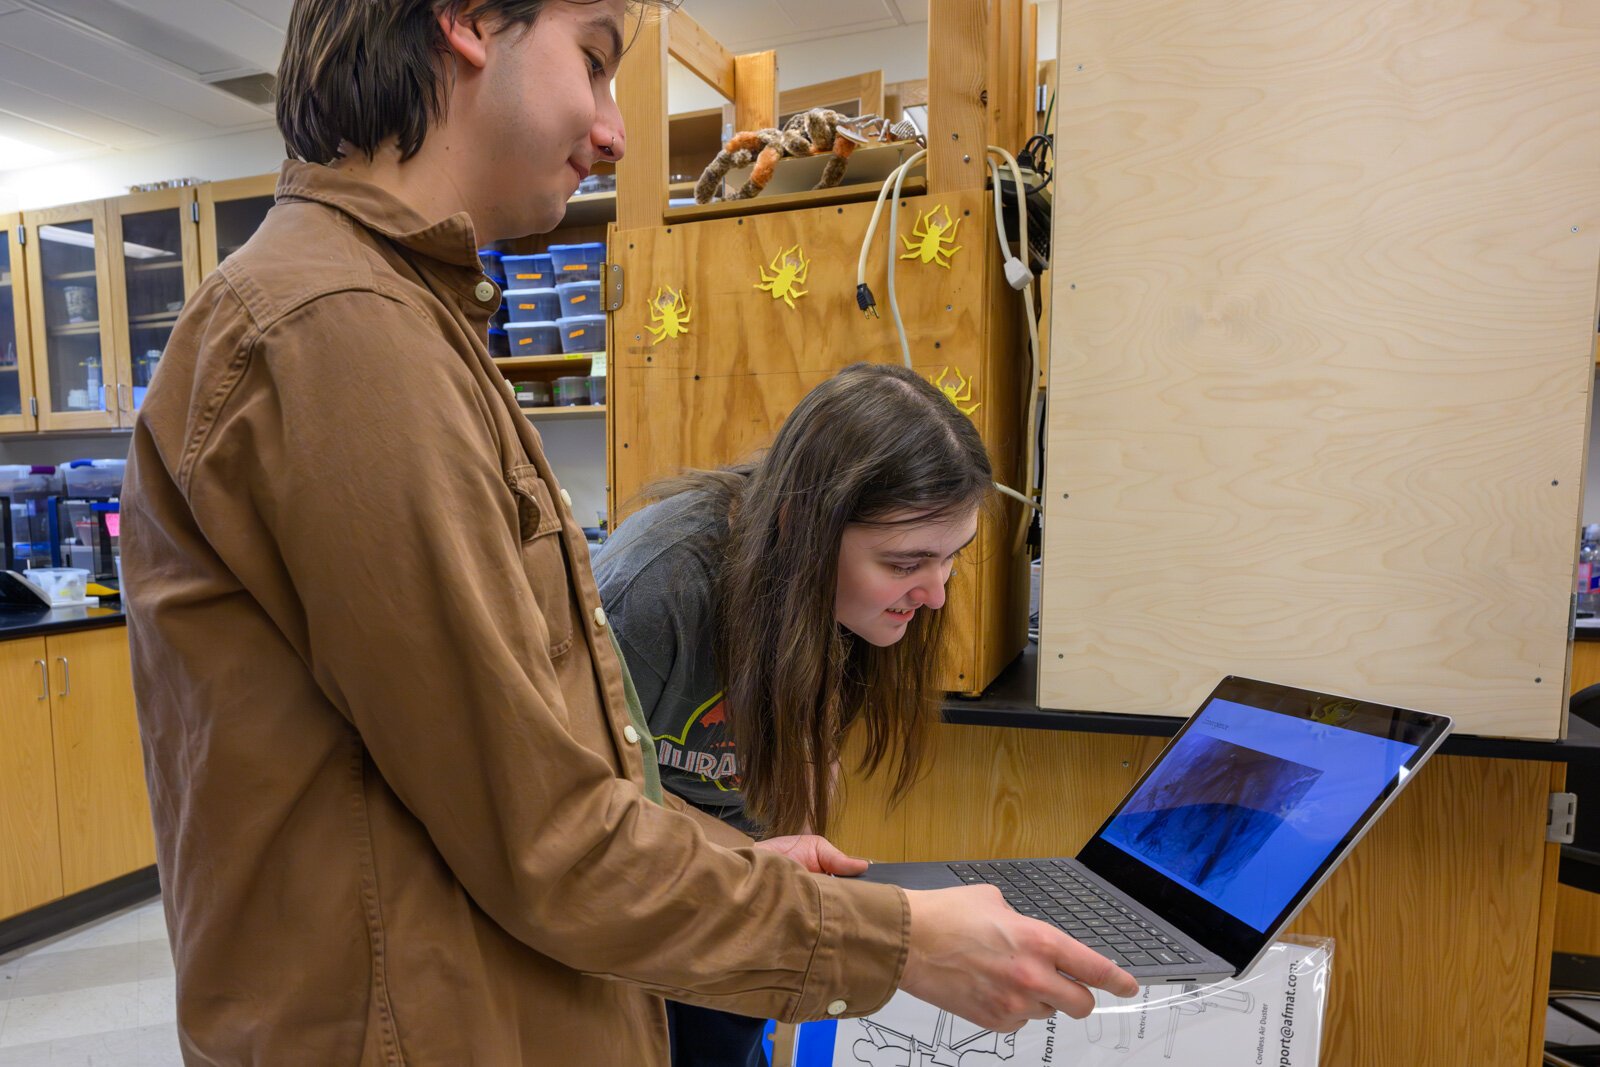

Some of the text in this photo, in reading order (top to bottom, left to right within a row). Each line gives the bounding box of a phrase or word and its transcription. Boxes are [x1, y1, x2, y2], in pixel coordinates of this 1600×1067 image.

[1138, 1015, 1147, 1039] Electric
[1255, 1003, 1269, 1065] Cordless Air Duster
[1280, 960, 1299, 1067] port@afmat.com.
[1042, 1036, 1055, 1063] from
